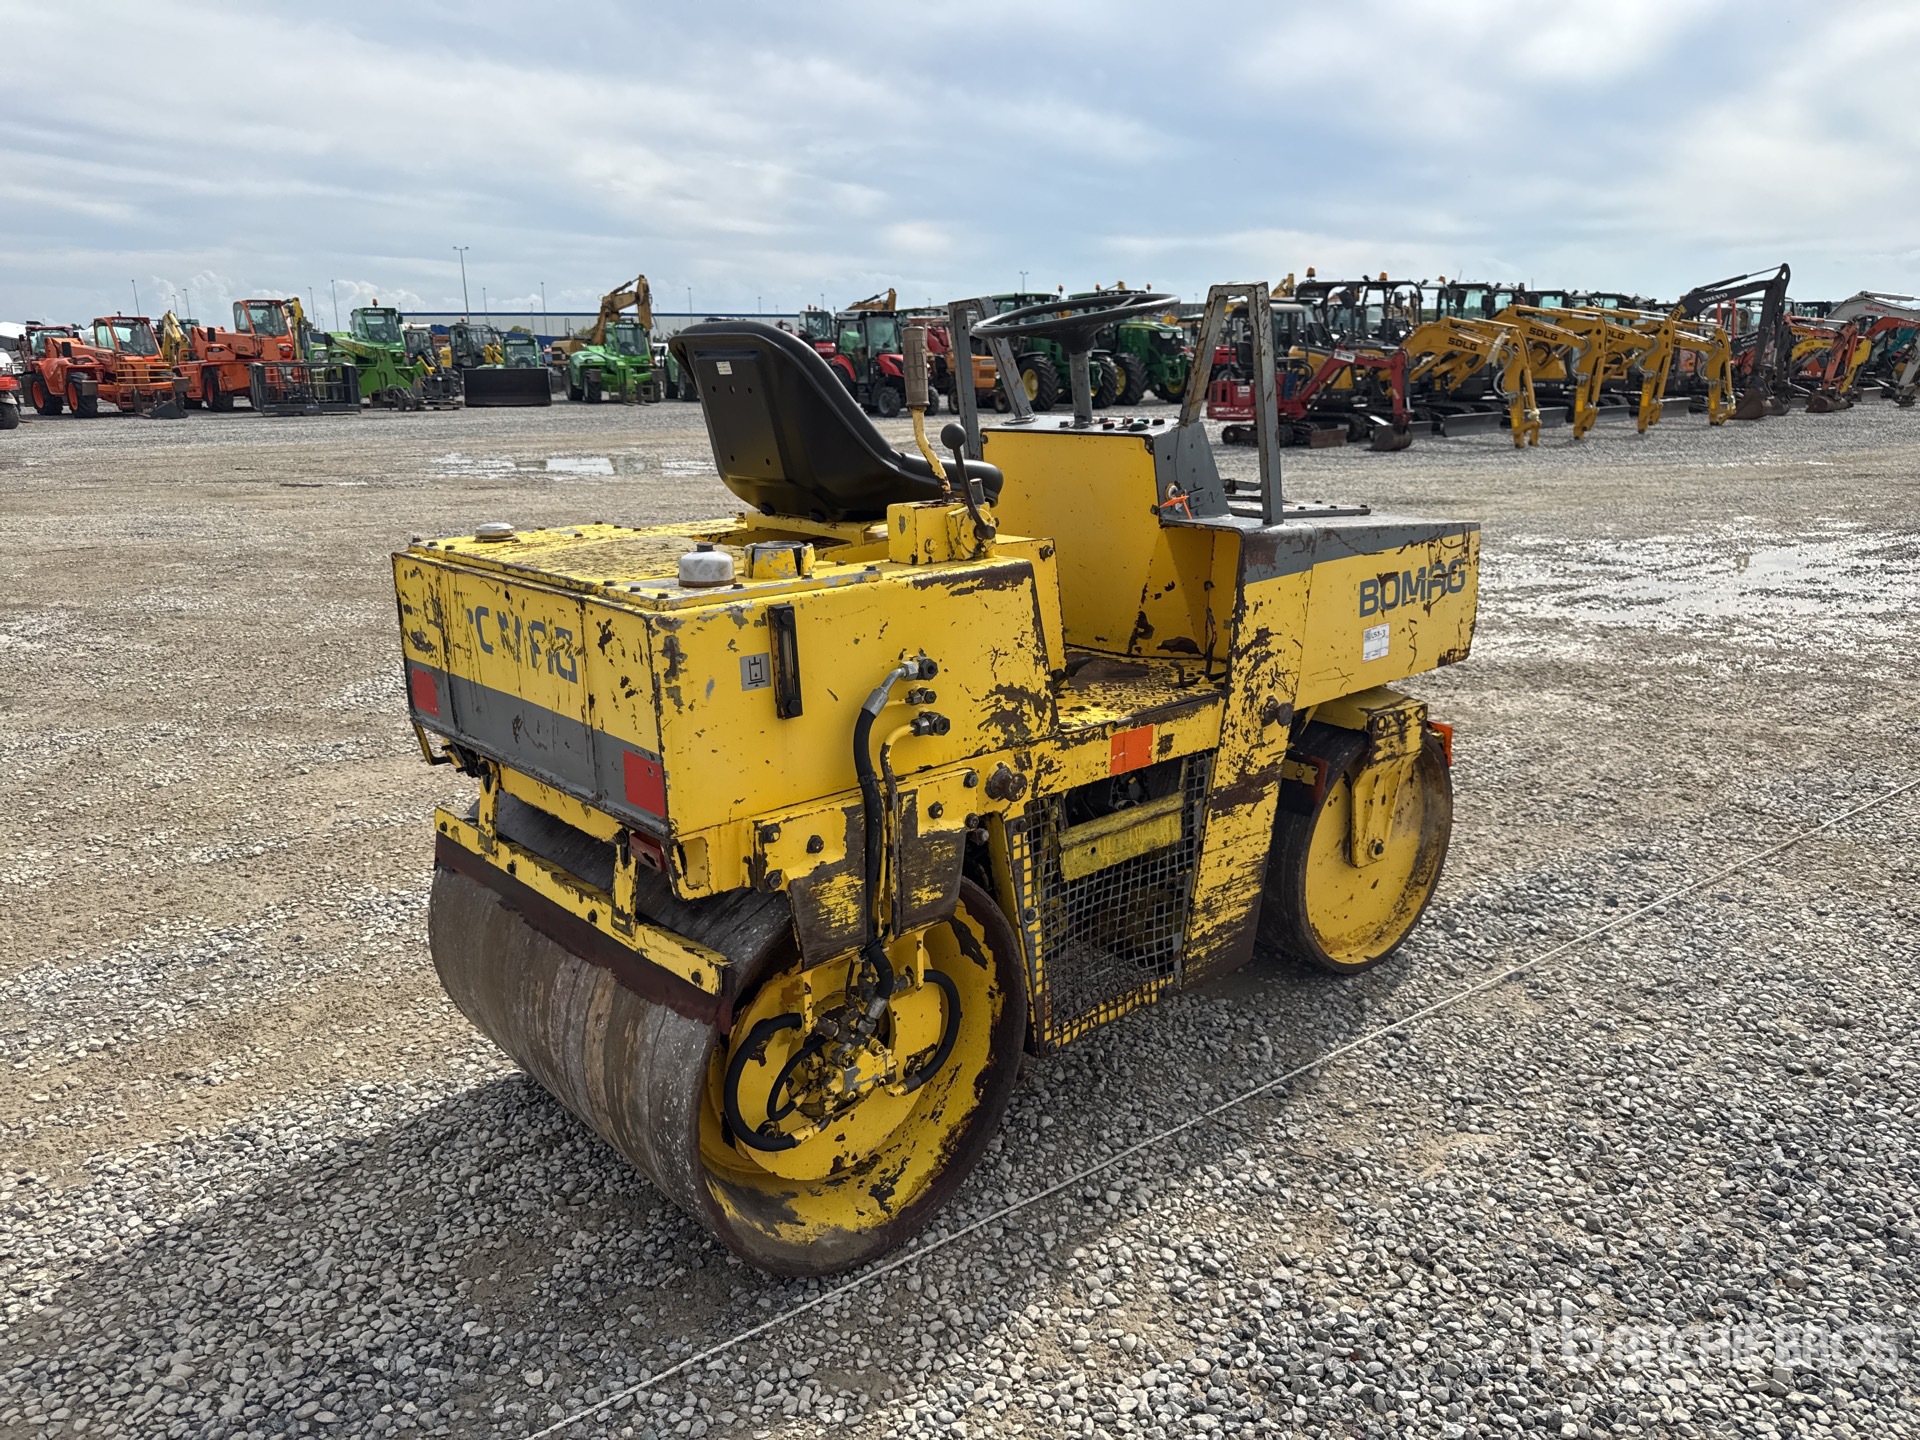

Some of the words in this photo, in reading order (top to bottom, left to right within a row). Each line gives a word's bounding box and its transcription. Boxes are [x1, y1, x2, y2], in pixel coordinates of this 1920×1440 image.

[1699, 292, 1728, 304] VOLVO
[1528, 327, 1559, 341] SDLG
[1447, 336, 1478, 352] SDLG
[1359, 558, 1466, 618] BOMAG
